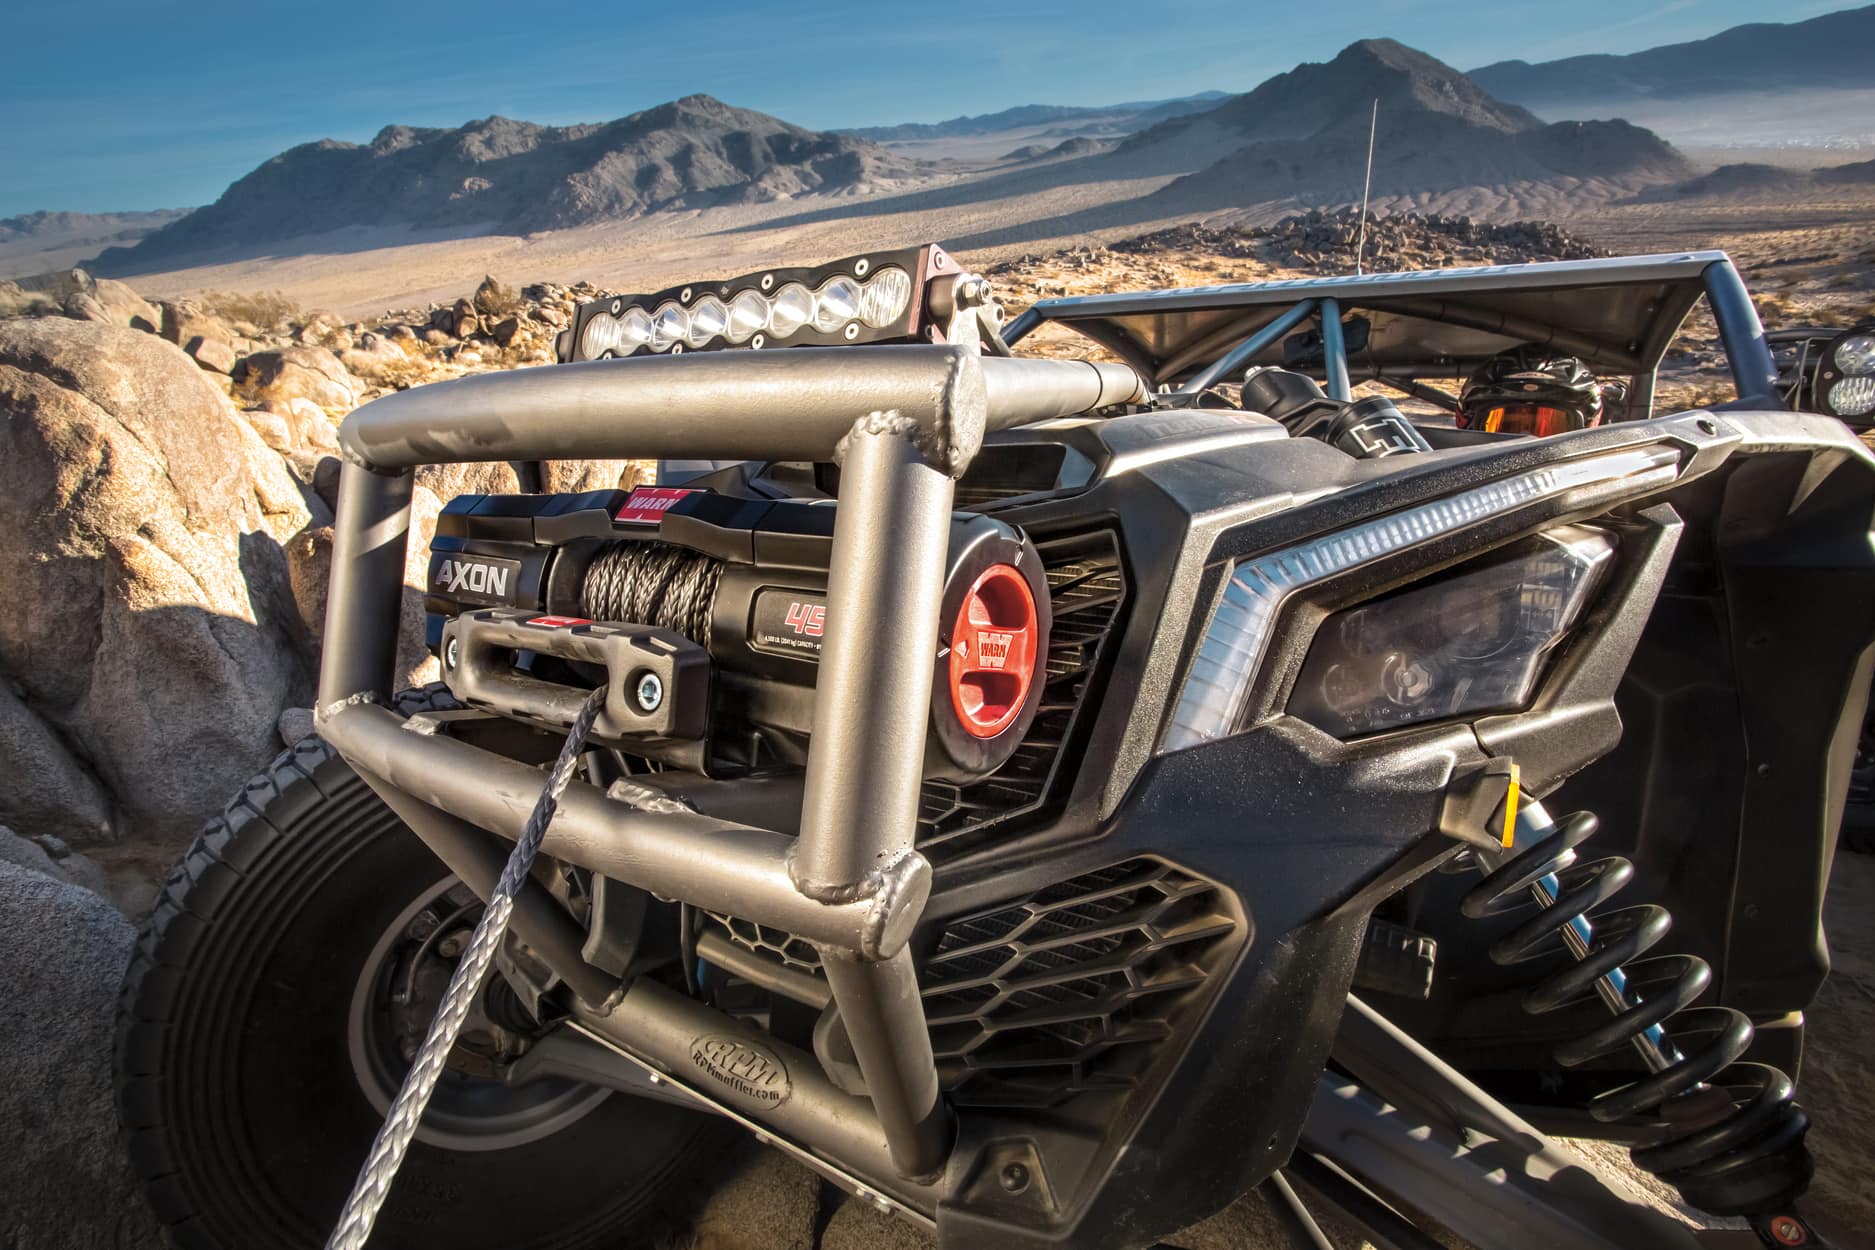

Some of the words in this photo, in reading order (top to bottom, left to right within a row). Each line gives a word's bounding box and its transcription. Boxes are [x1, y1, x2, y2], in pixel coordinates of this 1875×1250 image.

[627, 497, 680, 510] WARN
[435, 560, 508, 596] AXON
[981, 642, 1006, 658] WARN
[705, 1040, 778, 1085] RPM
